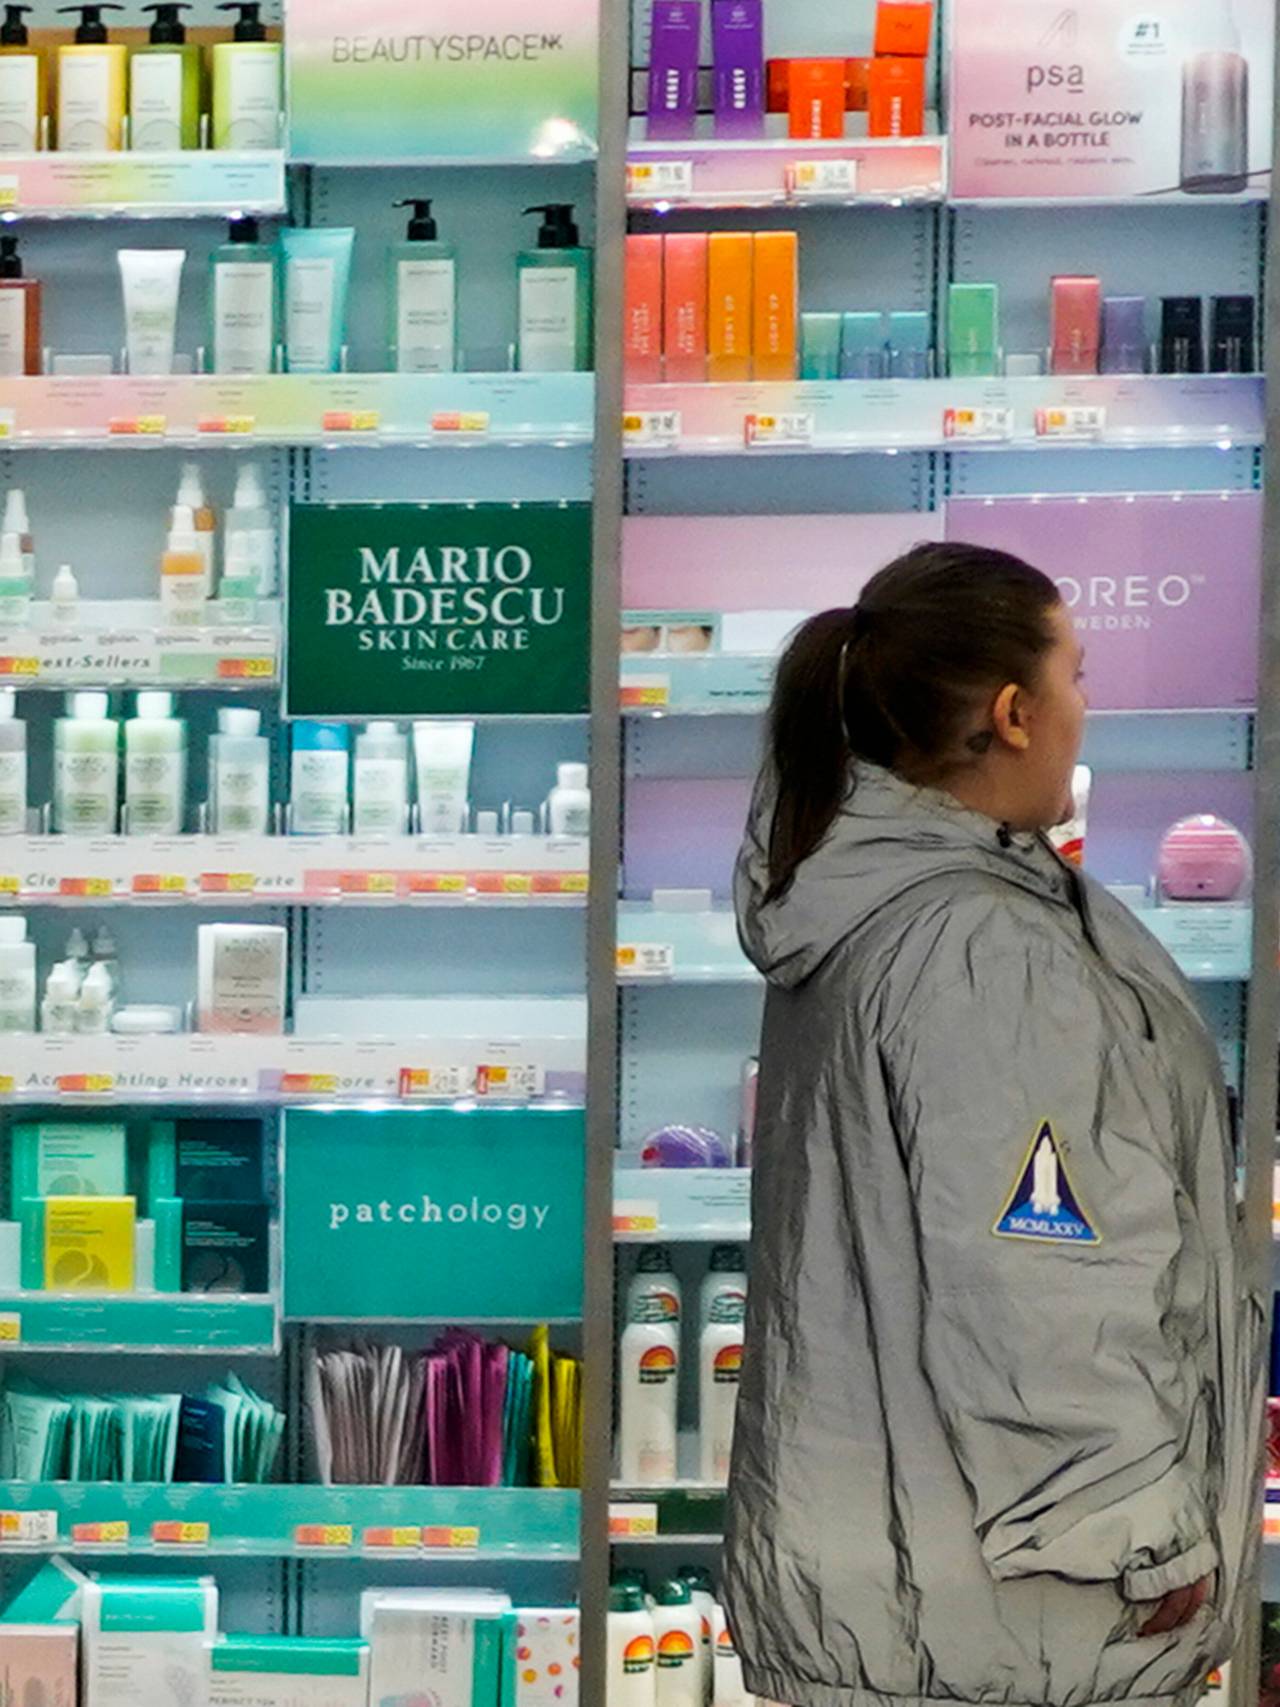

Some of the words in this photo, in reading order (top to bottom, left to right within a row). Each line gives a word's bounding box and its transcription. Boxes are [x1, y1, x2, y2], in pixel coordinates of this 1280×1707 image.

[1135, 22, 1160, 38] #1
[1026, 64, 1084, 93] psa
[969, 112, 1083, 127] POST-FACIAL
[1088, 111, 1143, 126] GLOW
[1005, 133, 1022, 147] IN
[1026, 133, 1040, 147] A
[1044, 132, 1110, 147] BOTTLE
[358, 546, 532, 584] MARIO
[1053, 575, 1190, 607] OREO
[324, 588, 565, 626] BADESCU
[1072, 614, 1152, 630] WEDEN
[358, 630, 438, 650] SKIN
[446, 630, 530, 650] CARE
[43, 654, 149, 668] est-Sellers
[402, 655, 445, 671] Since
[449, 655, 485, 672] 1967
[115, 1073, 168, 1087] hting
[179, 1073, 248, 1086] Heroes
[330, 1196, 549, 1229] patchology
